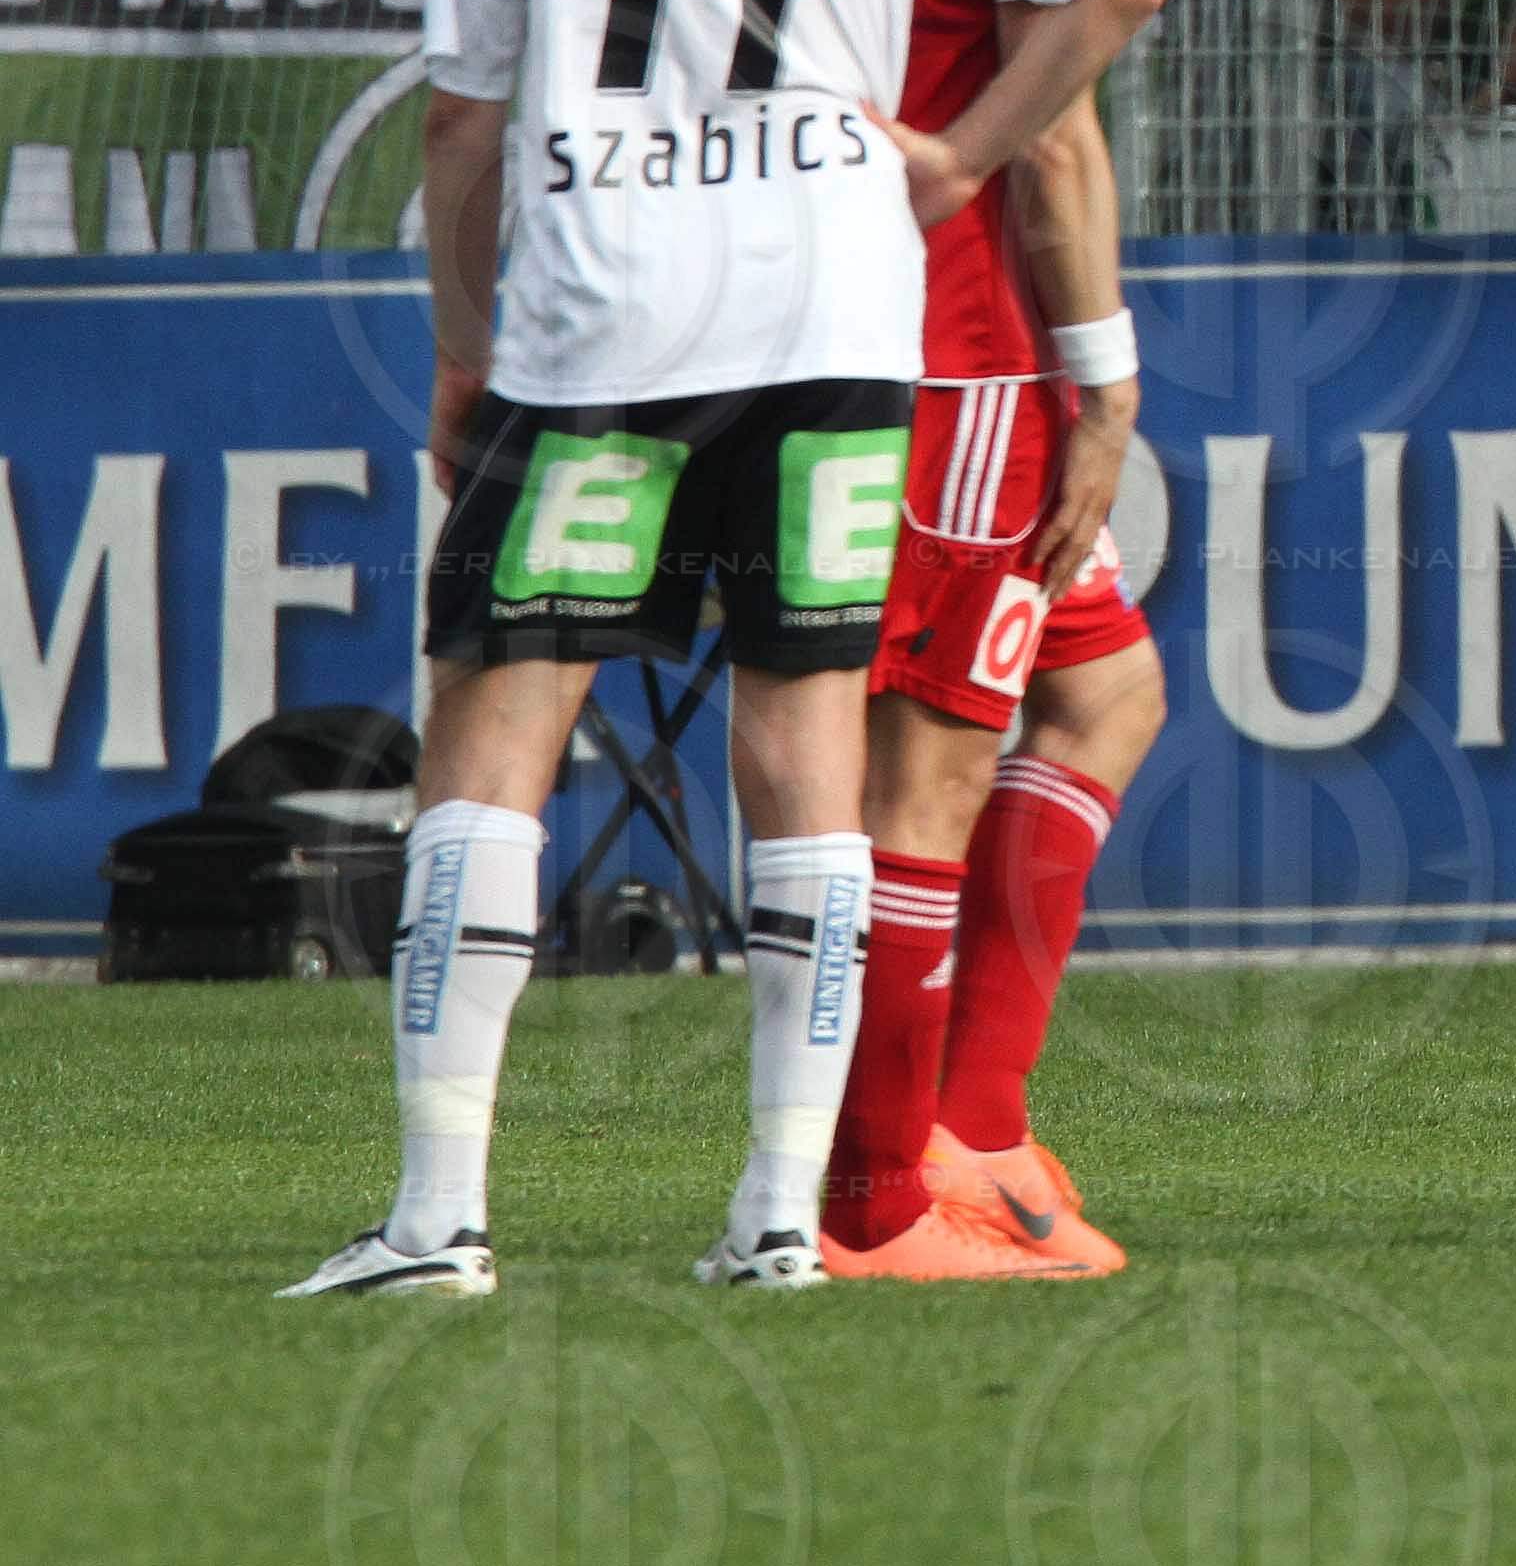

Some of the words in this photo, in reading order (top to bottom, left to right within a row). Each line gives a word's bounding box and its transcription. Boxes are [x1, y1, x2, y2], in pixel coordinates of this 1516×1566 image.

[546, 104, 869, 193] szabics
[524, 452, 650, 577] E
[807, 453, 900, 583] E
